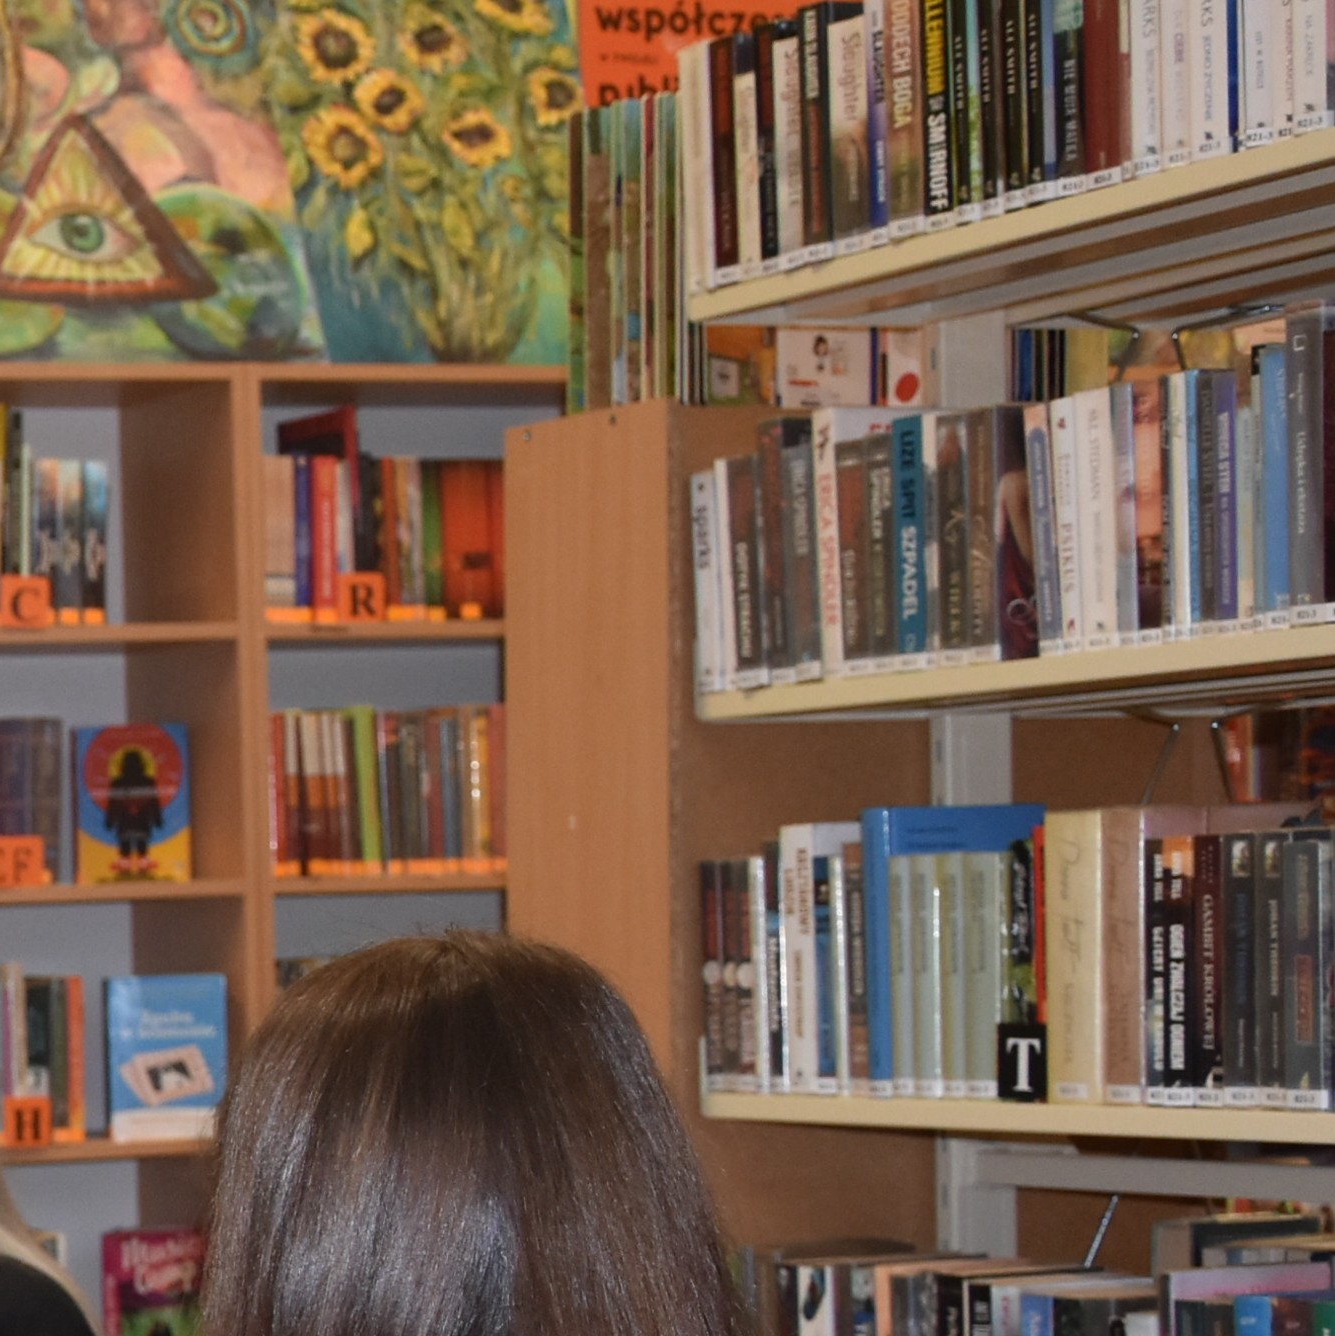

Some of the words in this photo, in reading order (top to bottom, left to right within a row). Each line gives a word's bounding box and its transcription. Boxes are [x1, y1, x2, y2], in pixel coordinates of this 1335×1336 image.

[893, 77, 912, 128] BOGA
[927, 112, 949, 210] SMIRNOFF
[900, 431, 915, 472] LIZE
[901, 477, 917, 519] SPIT
[900, 525, 918, 620] SZPADEL
[1060, 523, 1075, 594] PSIKUS
[11, 586, 45, 622] C
[350, 584, 377, 617] R
[1201, 894, 1216, 958] GAMBIT
[1201, 963, 1218, 1050] KRÓLOWEJ
[1006, 1037, 1041, 1092] T
[13, 1106, 44, 1143] H
